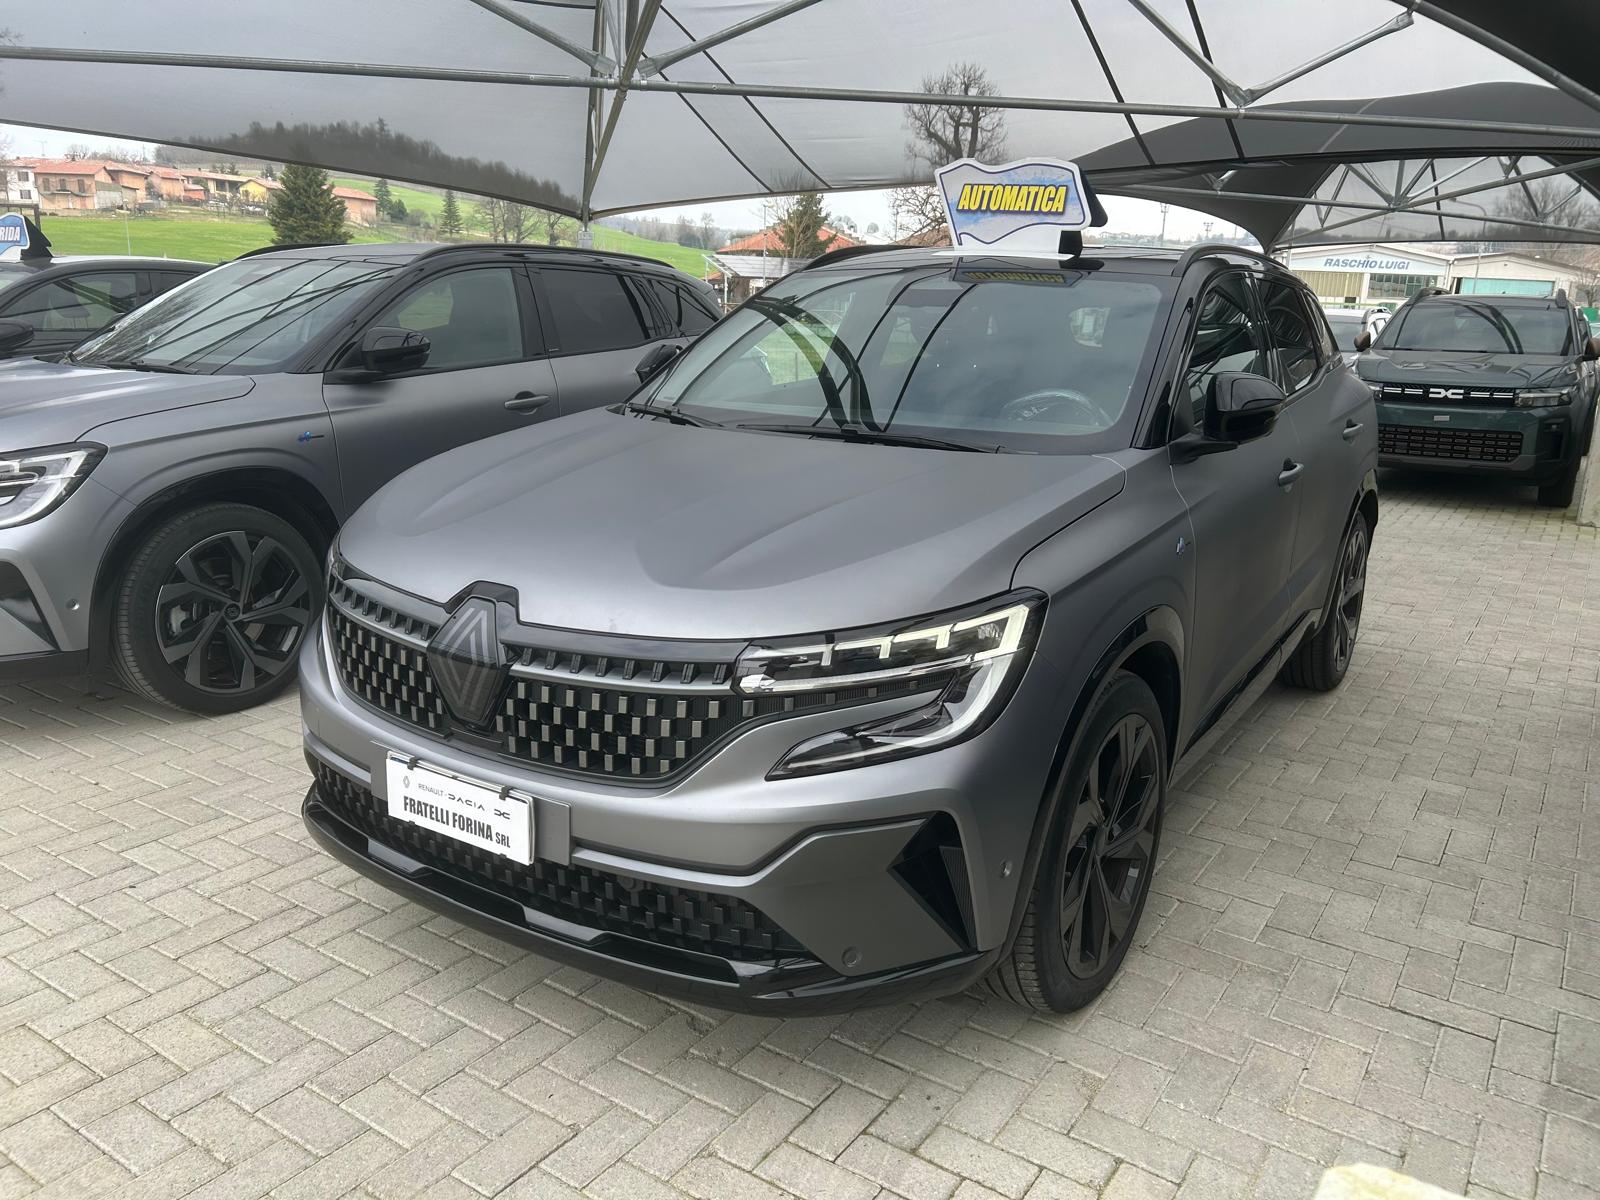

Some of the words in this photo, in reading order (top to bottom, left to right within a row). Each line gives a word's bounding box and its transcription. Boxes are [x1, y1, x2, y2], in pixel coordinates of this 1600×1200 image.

[957, 184, 1067, 214] AUTOMATICA
[1324, 258, 1377, 269] RASCHIO
[1378, 260, 1410, 270] LUIGI
[418, 783, 444, 797] RENAULT
[447, 793, 486, 811] DACIA
[403, 795, 450, 826] FRATELLI
[453, 812, 493, 842] FORINA
[495, 832, 511, 848] SRL
